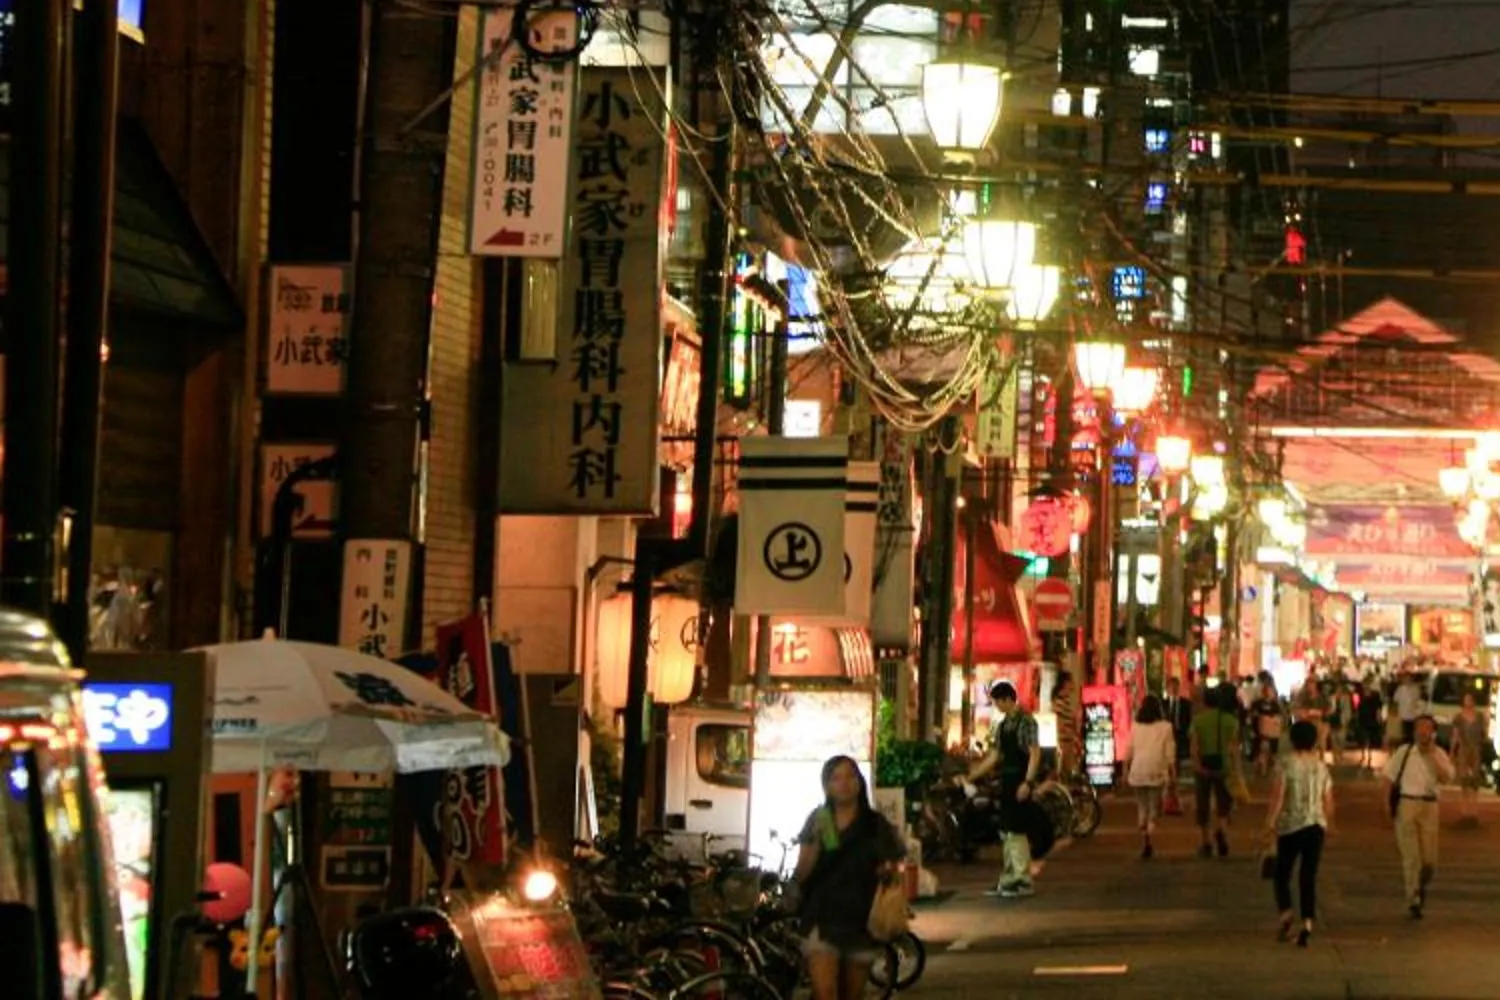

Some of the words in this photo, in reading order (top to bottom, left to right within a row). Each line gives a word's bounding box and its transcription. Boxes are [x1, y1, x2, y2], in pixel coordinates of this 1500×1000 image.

[566, 80, 629, 499] 小武家胃腸科内科
